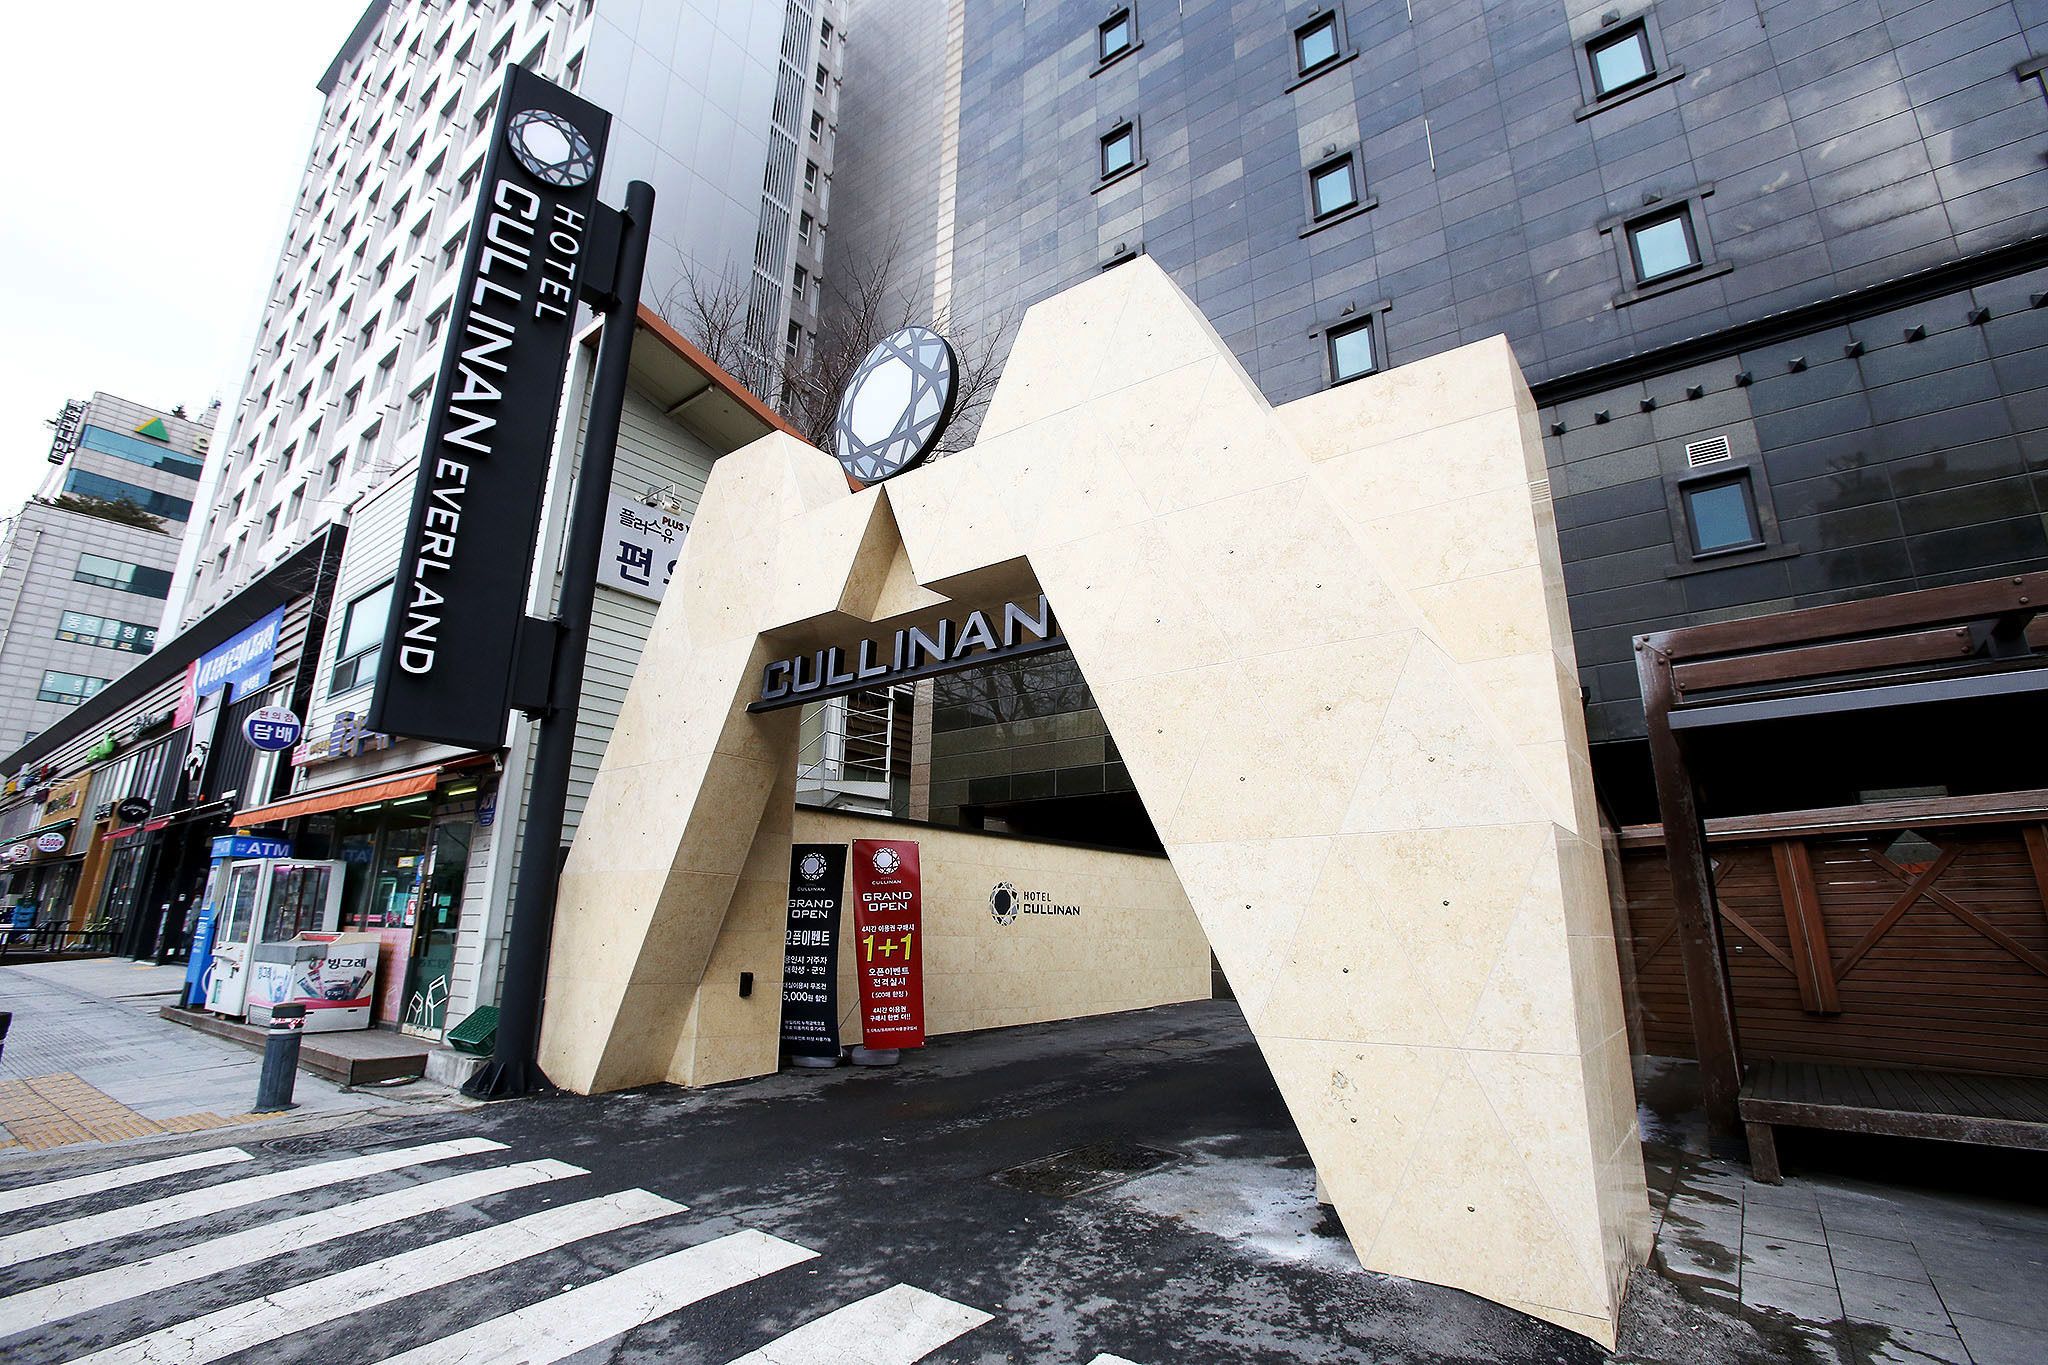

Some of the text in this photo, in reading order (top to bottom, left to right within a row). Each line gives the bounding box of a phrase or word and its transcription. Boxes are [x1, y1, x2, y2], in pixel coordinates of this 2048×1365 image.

[536, 202, 585, 319] HOTEL
[399, 179, 540, 675] CULLINAN EVERLAND
[619, 507, 675, 544] 플러스유
[661, 516, 684, 532] PLUS
[761, 594, 1049, 700] CULLINAN
[259, 710, 294, 723] 편의점
[254, 723, 293, 743] 담배
[247, 842, 290, 857] ATM
[862, 891, 913, 902] GRAND
[1023, 891, 1051, 901] HOTEL
[788, 899, 834, 908] GRAND
[868, 901, 908, 912] OPEN
[1023, 903, 1080, 915] CULLINAN
[791, 909, 829, 919] OPEN
[785, 929, 830, 946] 오픈이벤트
[863, 933, 912, 962] 1+1
[327, 957, 367, 970] 빙그레
[806, 955, 828, 965] 거주자
[868, 966, 910, 977] 오픈이벤트
[873, 976, 906, 987] 전격실시
